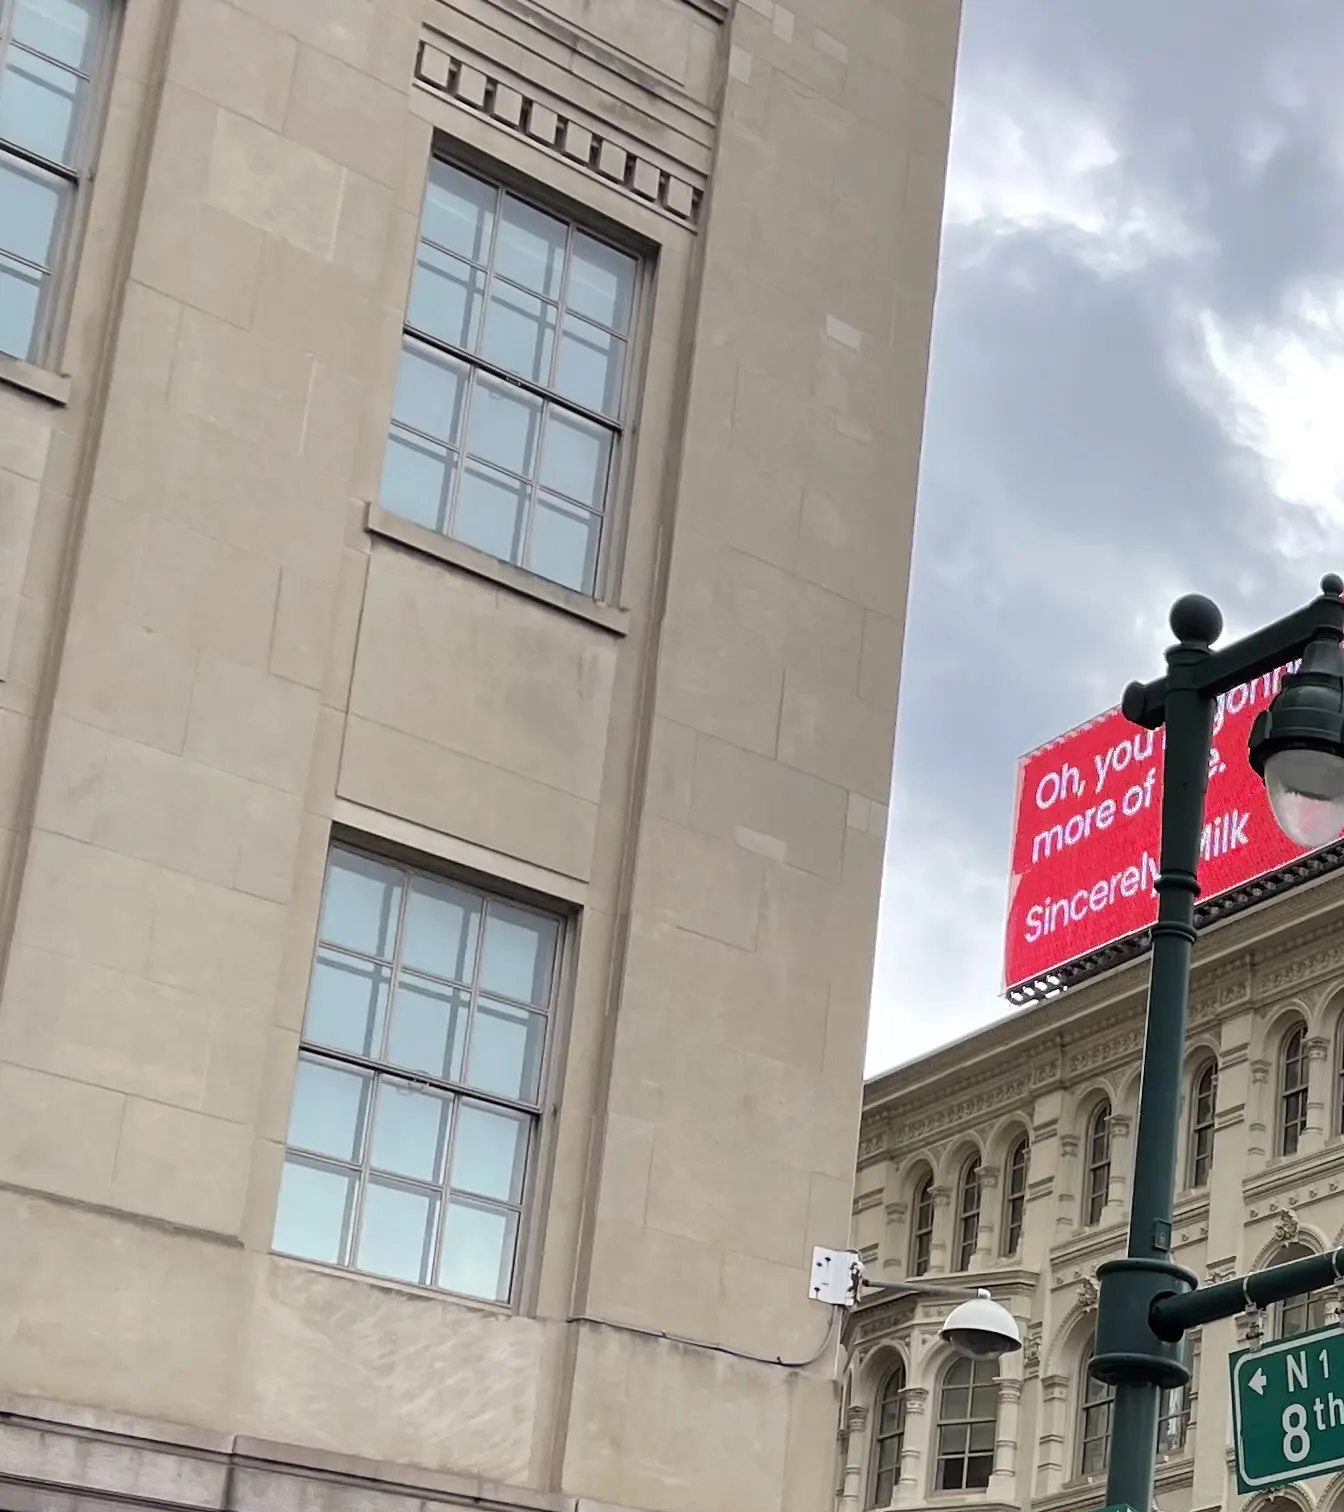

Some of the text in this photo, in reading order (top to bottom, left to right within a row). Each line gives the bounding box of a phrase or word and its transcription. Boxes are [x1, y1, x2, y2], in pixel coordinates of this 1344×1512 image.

[1032, 767, 1156, 863] more of
[1035, 762, 1086, 810] Oh,
